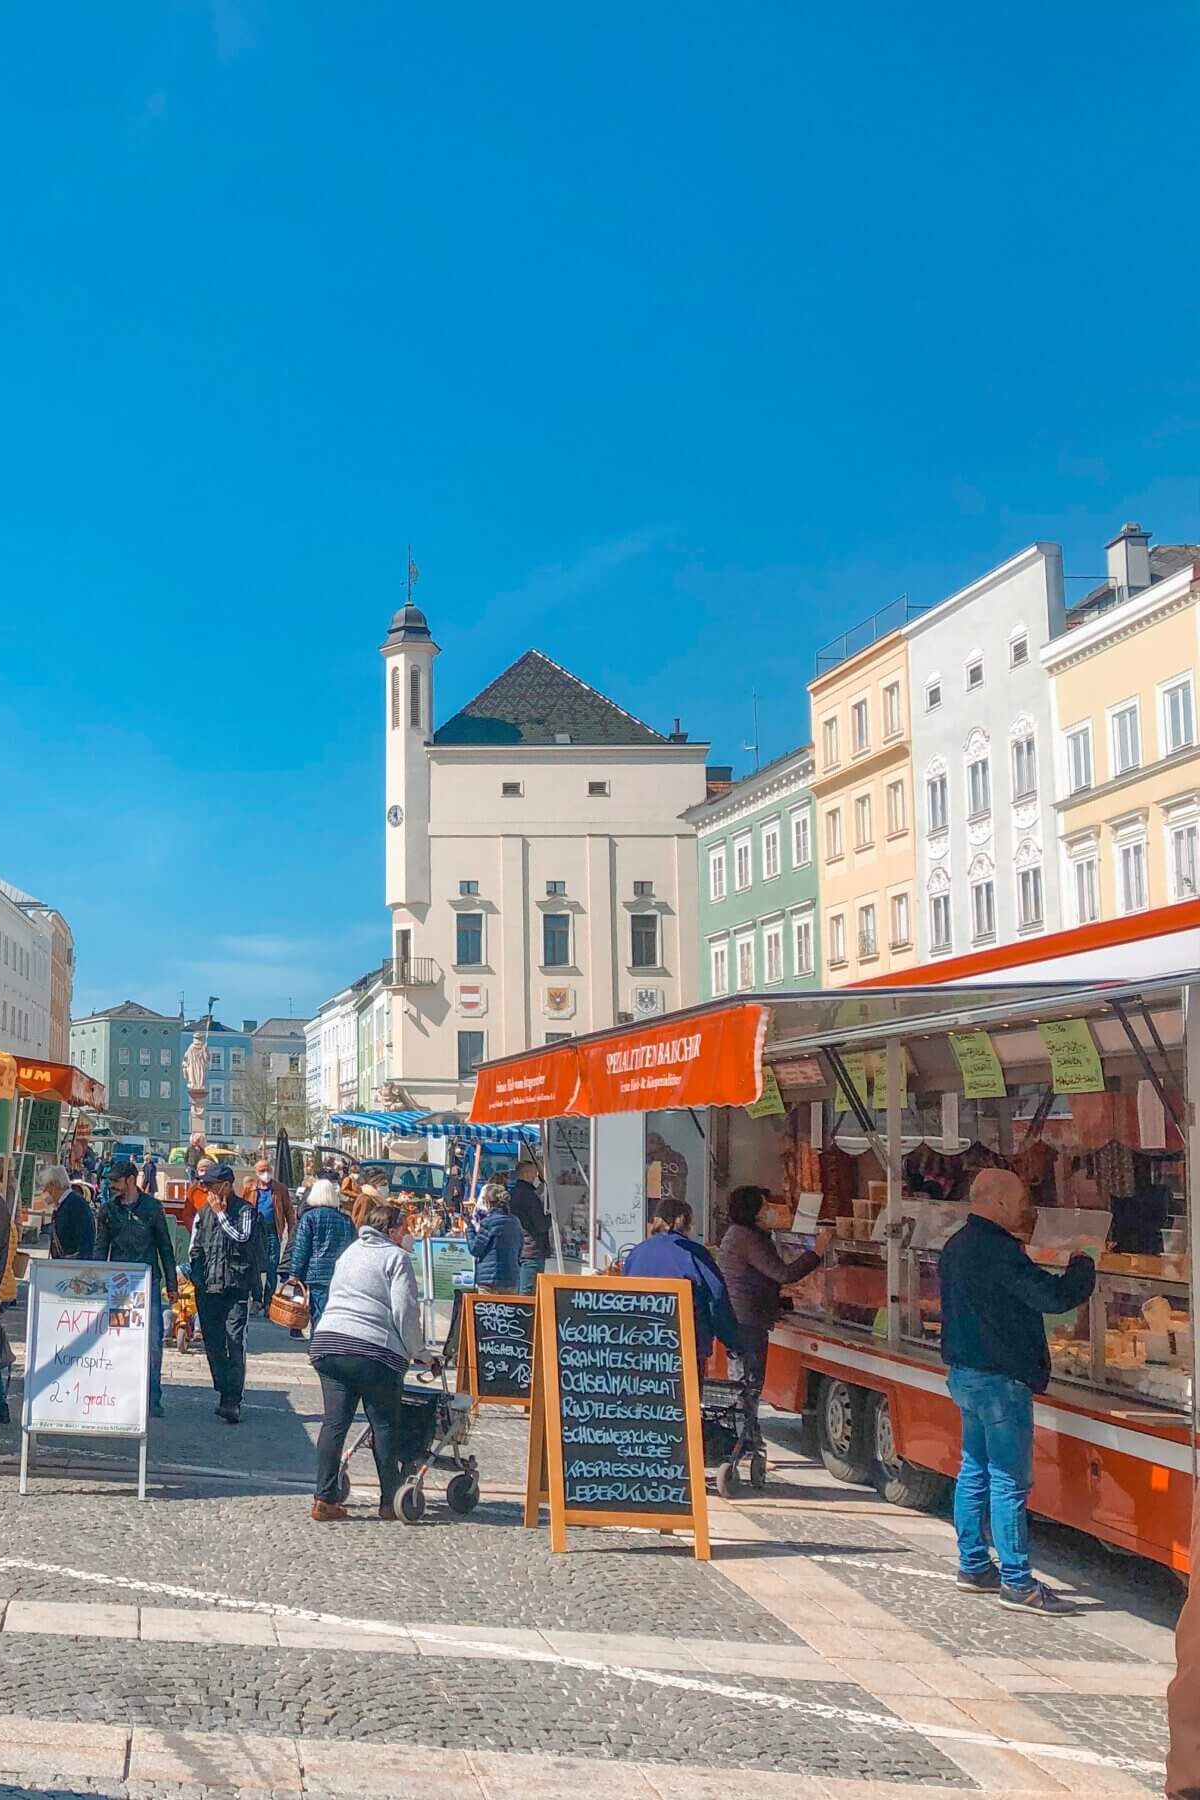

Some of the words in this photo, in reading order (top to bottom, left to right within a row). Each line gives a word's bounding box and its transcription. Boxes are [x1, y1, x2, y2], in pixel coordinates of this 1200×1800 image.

[571, 1291, 678, 1316] HAUSGEMACHT
[558, 1317, 680, 1349] VERHACKERTES
[53, 1344, 113, 1376] Kornspitz
[559, 1346, 682, 1373] GRAMMELSCHMALZ
[83, 1384, 116, 1415] gratis
[560, 1371, 680, 1400] OCHSENMAULSALAT
[617, 1445, 673, 1458] SULZE
[565, 1482, 692, 1505] LEBERKNÖDEL
